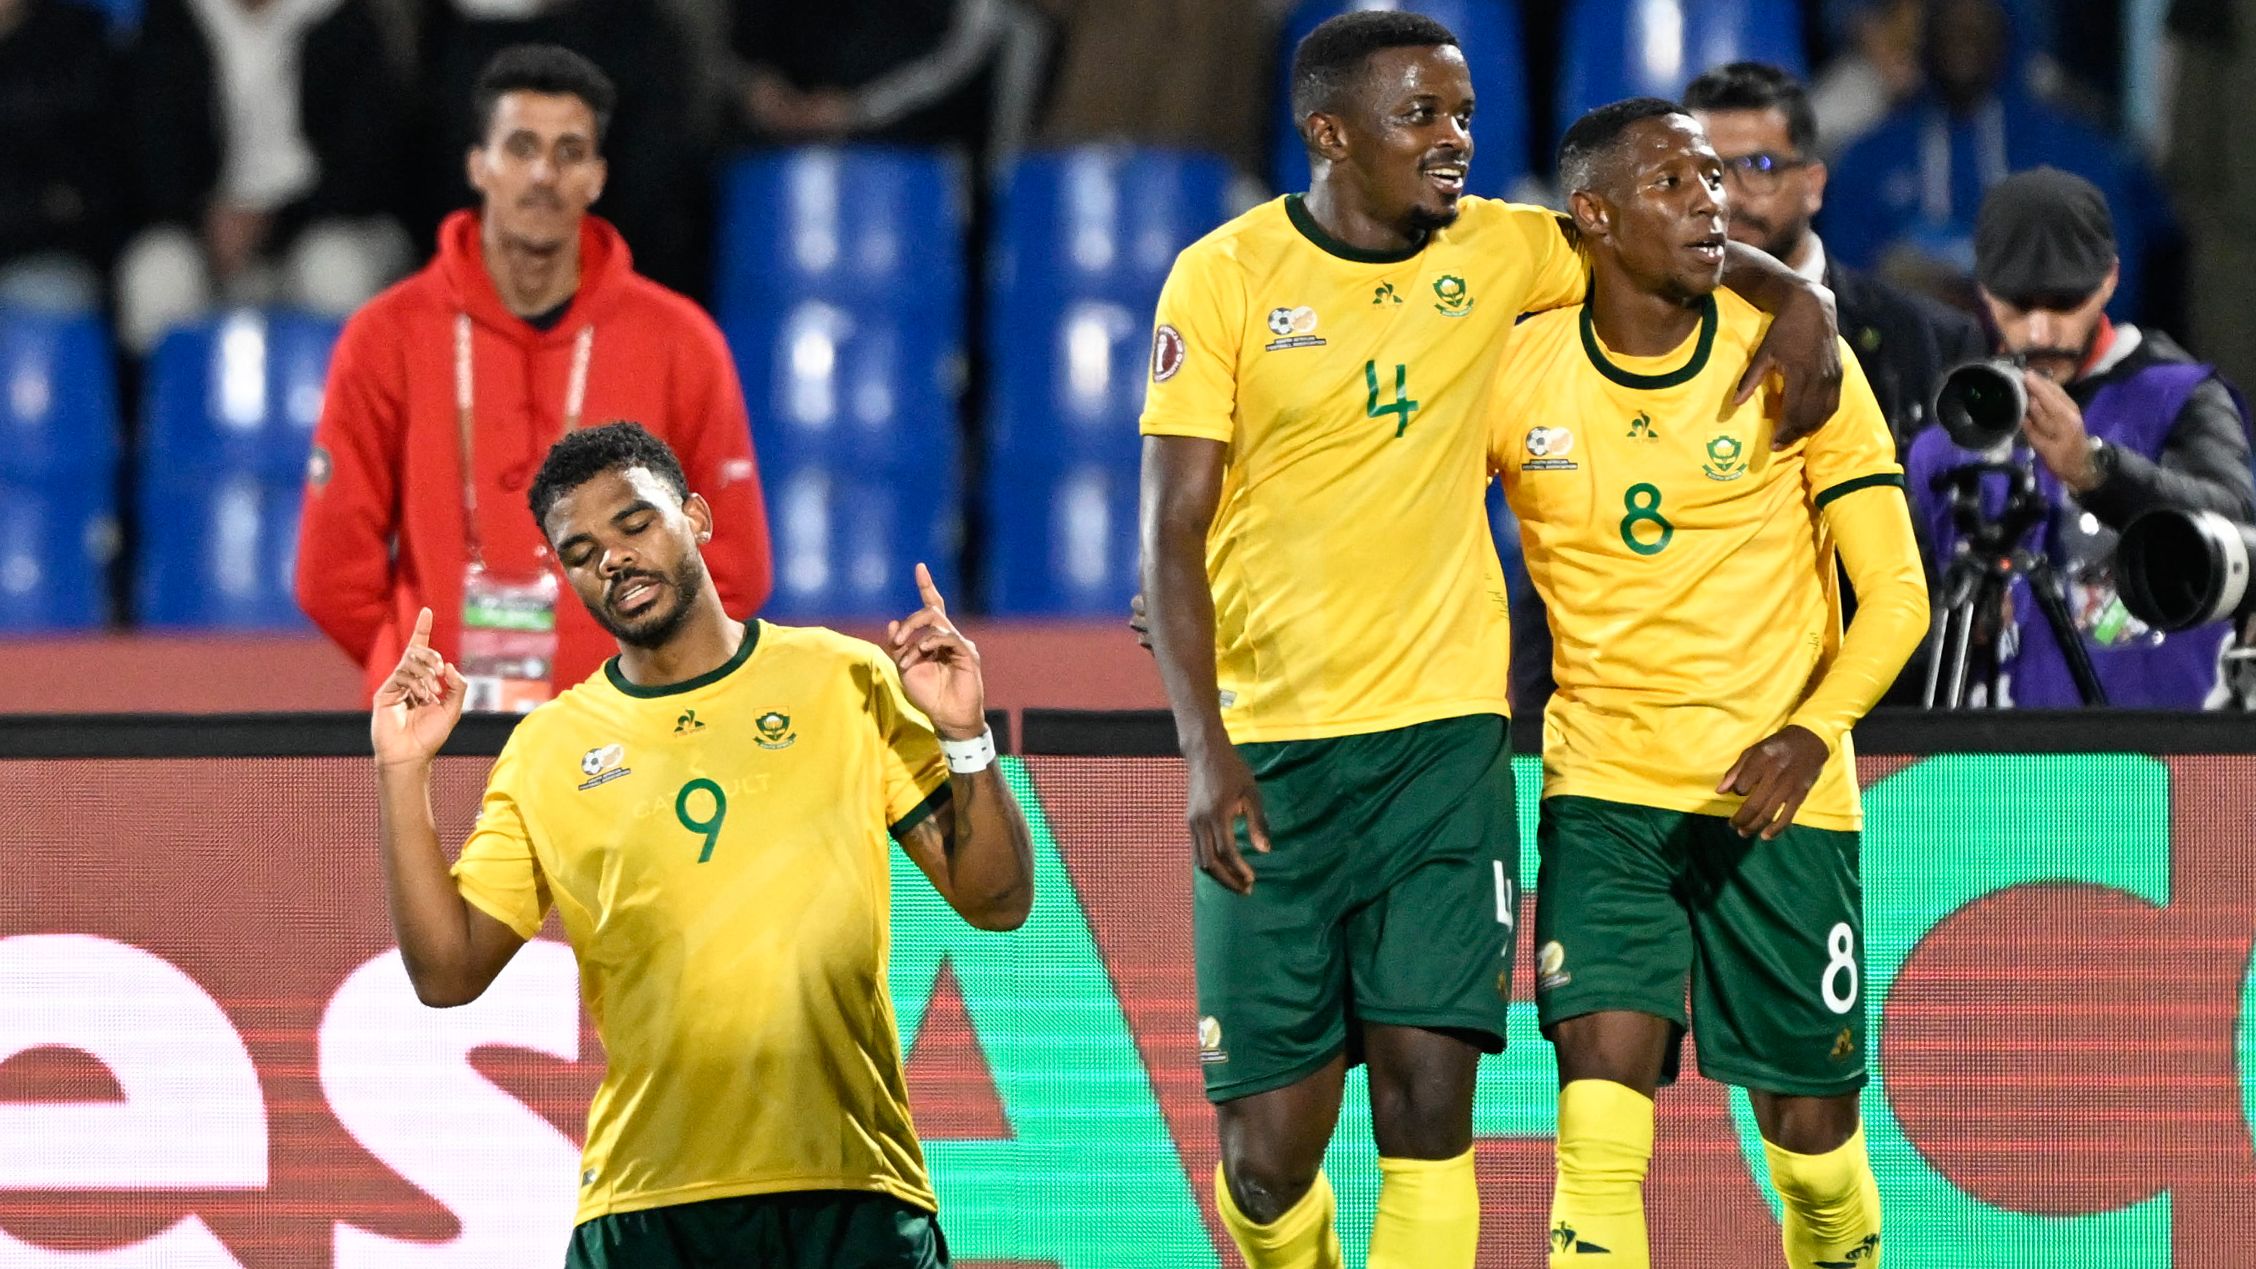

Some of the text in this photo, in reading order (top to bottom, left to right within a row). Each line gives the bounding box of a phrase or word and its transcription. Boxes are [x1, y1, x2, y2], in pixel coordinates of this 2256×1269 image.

[1365, 359, 1418, 437] 4
[1620, 482, 1673, 555] 8
[675, 778, 727, 863] 9
[1821, 922, 1859, 1015] 8
